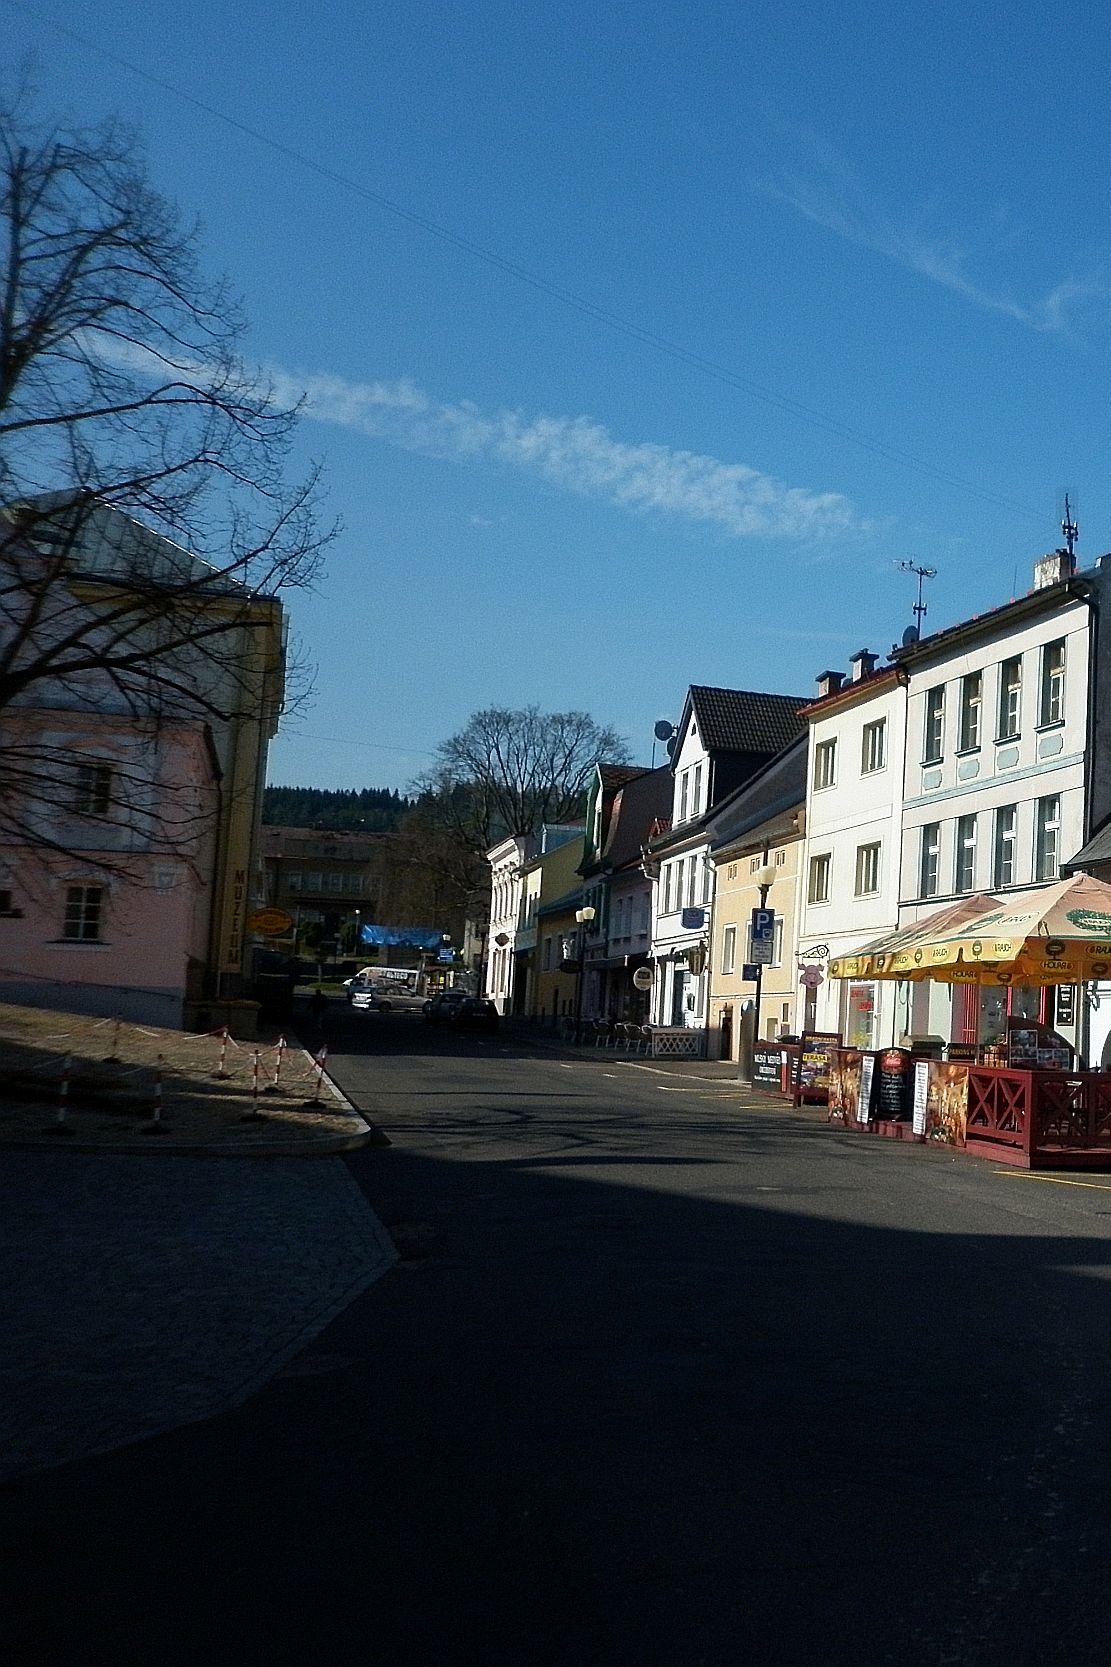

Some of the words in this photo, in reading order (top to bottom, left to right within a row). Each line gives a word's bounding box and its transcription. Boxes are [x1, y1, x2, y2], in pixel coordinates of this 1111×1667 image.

[228, 870, 245, 964] MUZEUM
[757, 912, 770, 930] P
[997, 942, 1012, 952] RAUCH
[803, 1053, 827, 1062] TERASA
